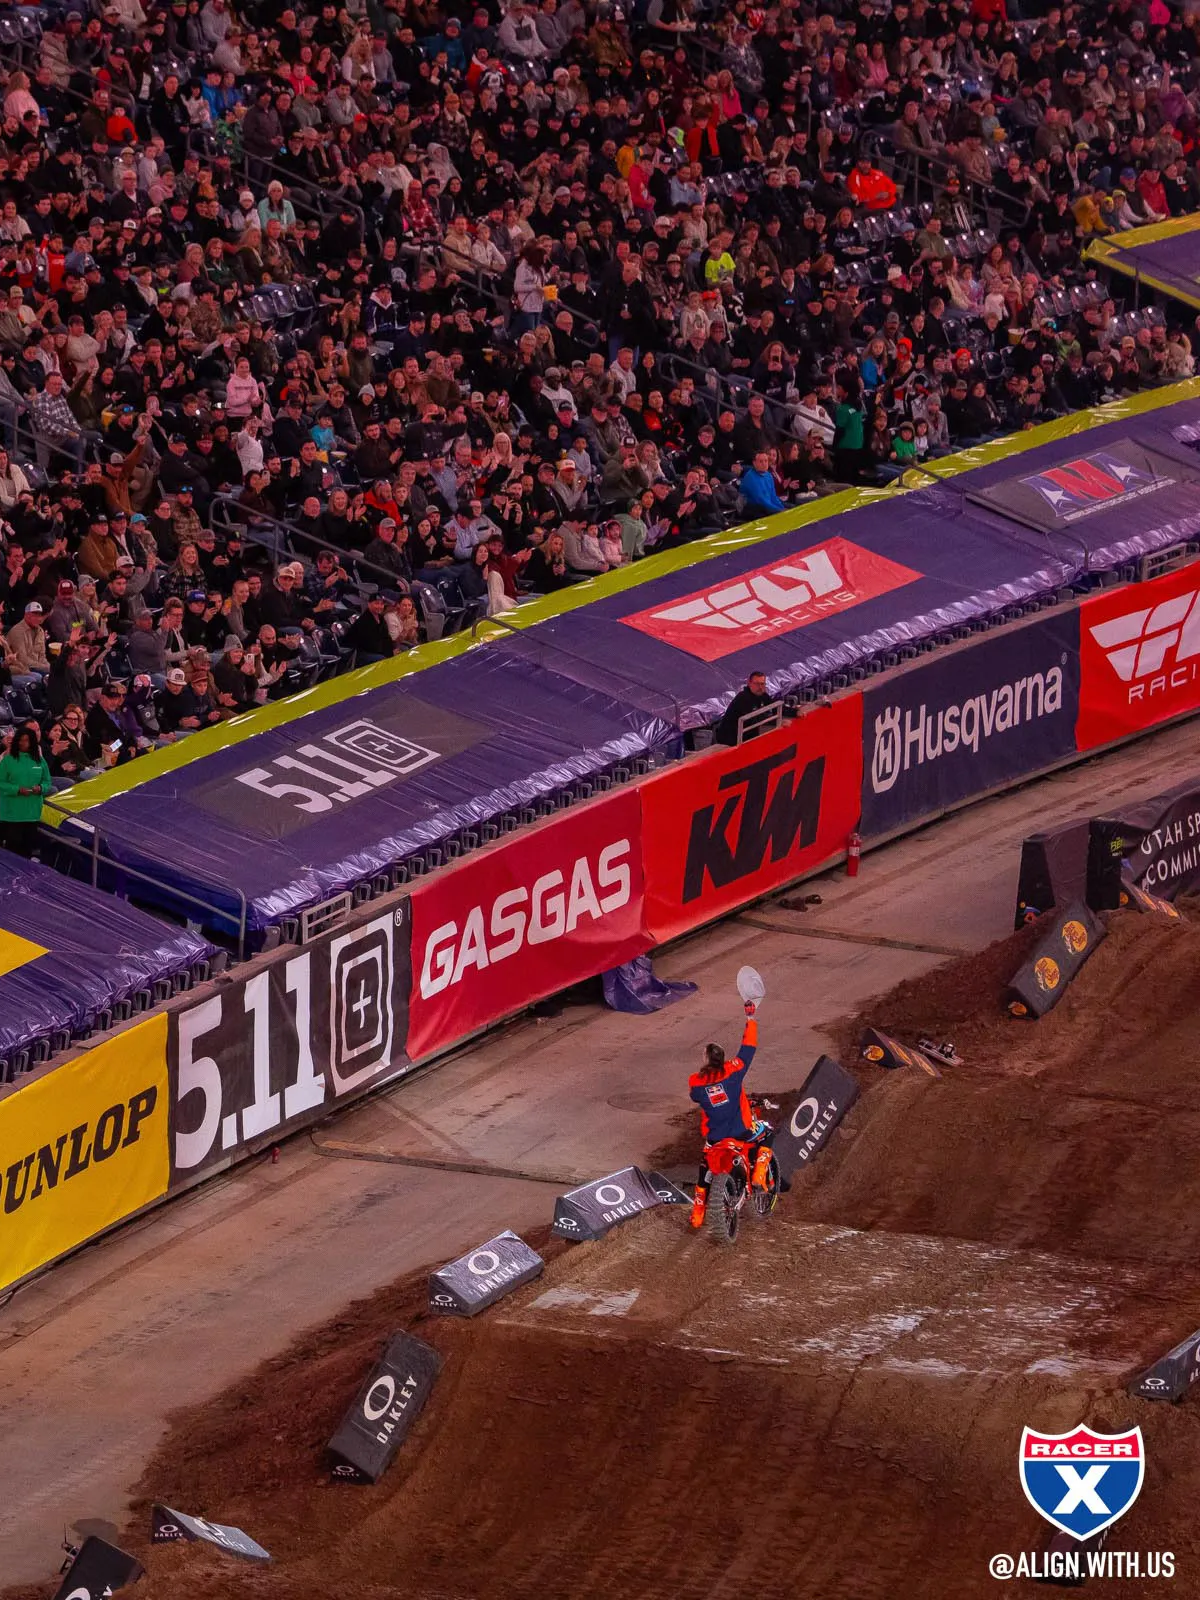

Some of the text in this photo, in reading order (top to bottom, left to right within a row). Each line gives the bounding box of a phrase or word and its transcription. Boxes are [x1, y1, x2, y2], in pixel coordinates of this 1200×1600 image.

[650, 550, 843, 629] FLY
[750, 591, 857, 635] RACING
[904, 666, 1063, 771] Husqvarna
[235, 745, 398, 814] 5.11
[683, 744, 826, 905] KTM
[1141, 821, 1183, 855] UTAH
[1146, 844, 1200, 885] COMMI
[420, 839, 631, 1000] GASGAS
[175, 952, 325, 1169] 5.11
[799, 1100, 838, 1160] OAKLEY
[602, 1199, 645, 1223] OAKLEY
[477, 1260, 521, 1293] OAKLEY
[376, 1375, 418, 1444] OAKLEY
